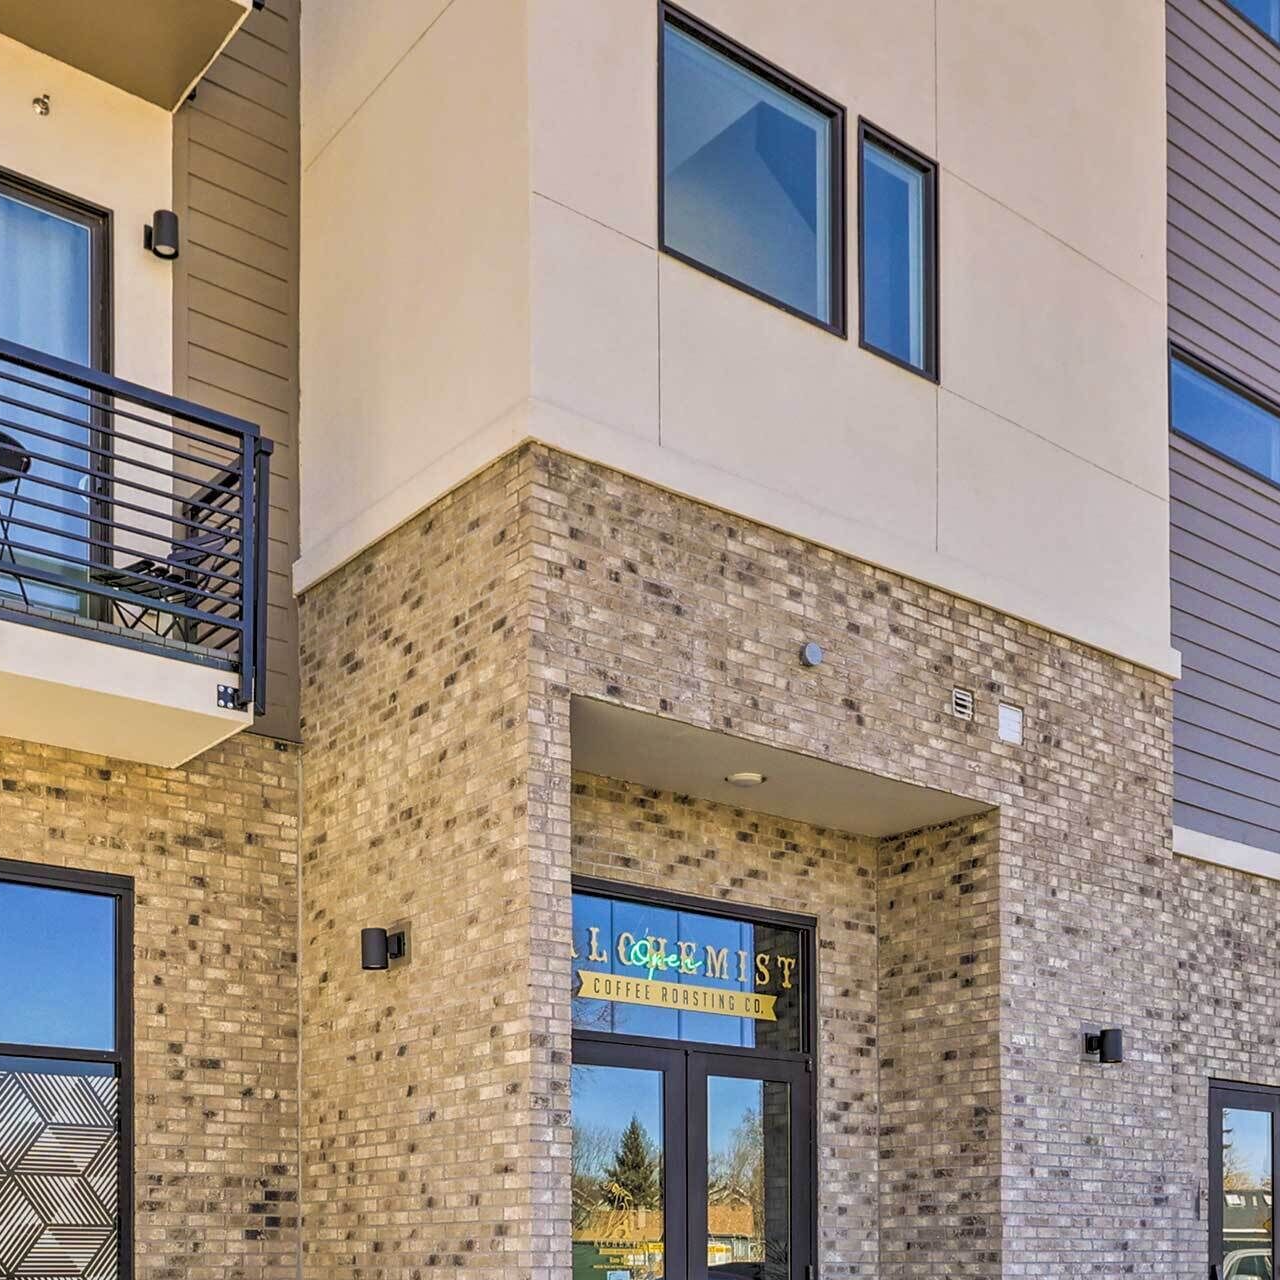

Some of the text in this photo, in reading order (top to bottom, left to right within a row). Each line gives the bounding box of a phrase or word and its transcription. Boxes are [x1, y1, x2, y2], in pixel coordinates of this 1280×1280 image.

[631, 939, 702, 980] Open
[593, 977, 765, 1014] COFFEE ROASTING CO.
